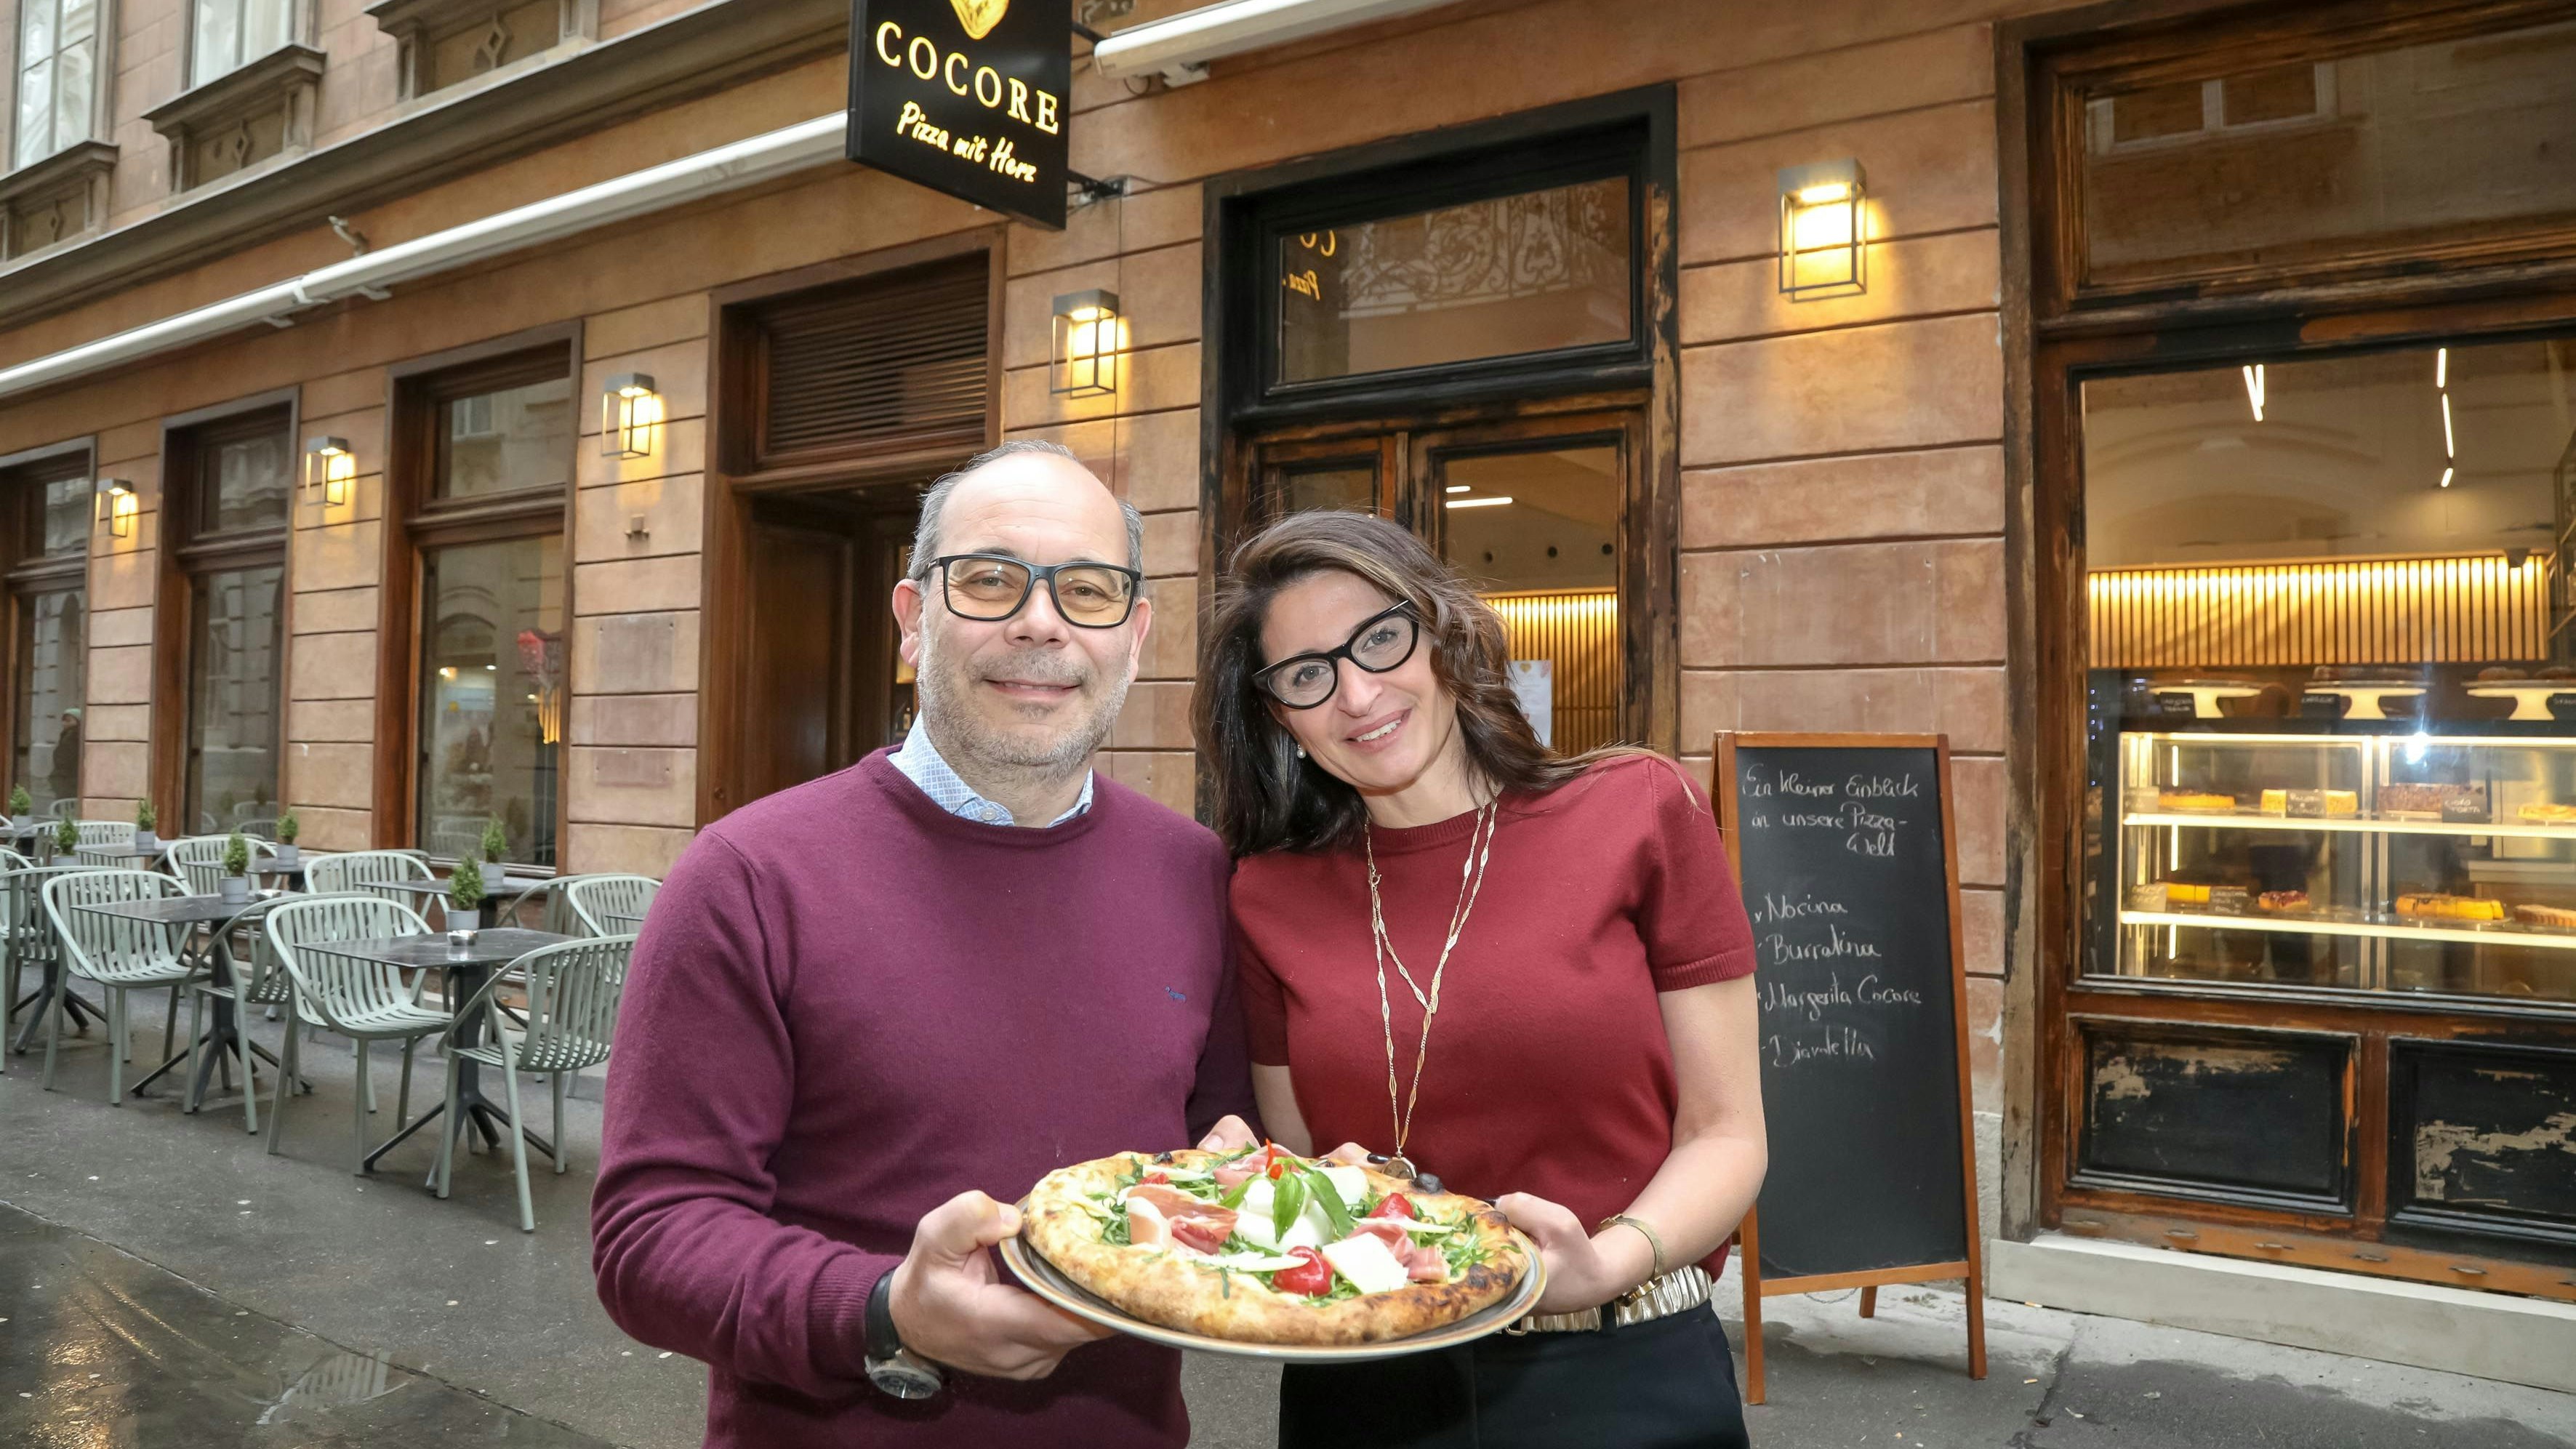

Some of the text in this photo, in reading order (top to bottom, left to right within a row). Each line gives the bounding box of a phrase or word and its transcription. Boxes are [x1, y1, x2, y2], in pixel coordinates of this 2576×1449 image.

[876, 21, 1059, 135] COCORE
[896, 100, 1037, 182] Pizza mit Herz
[1780, 769, 1836, 797] kleiner
[1845, 774, 1919, 798] Einblick
[1783, 815, 1844, 829] unsere
[1847, 832, 1895, 856] Welt
[1766, 923, 1882, 964] Burratina
[1858, 974, 1922, 1004] Cocore
